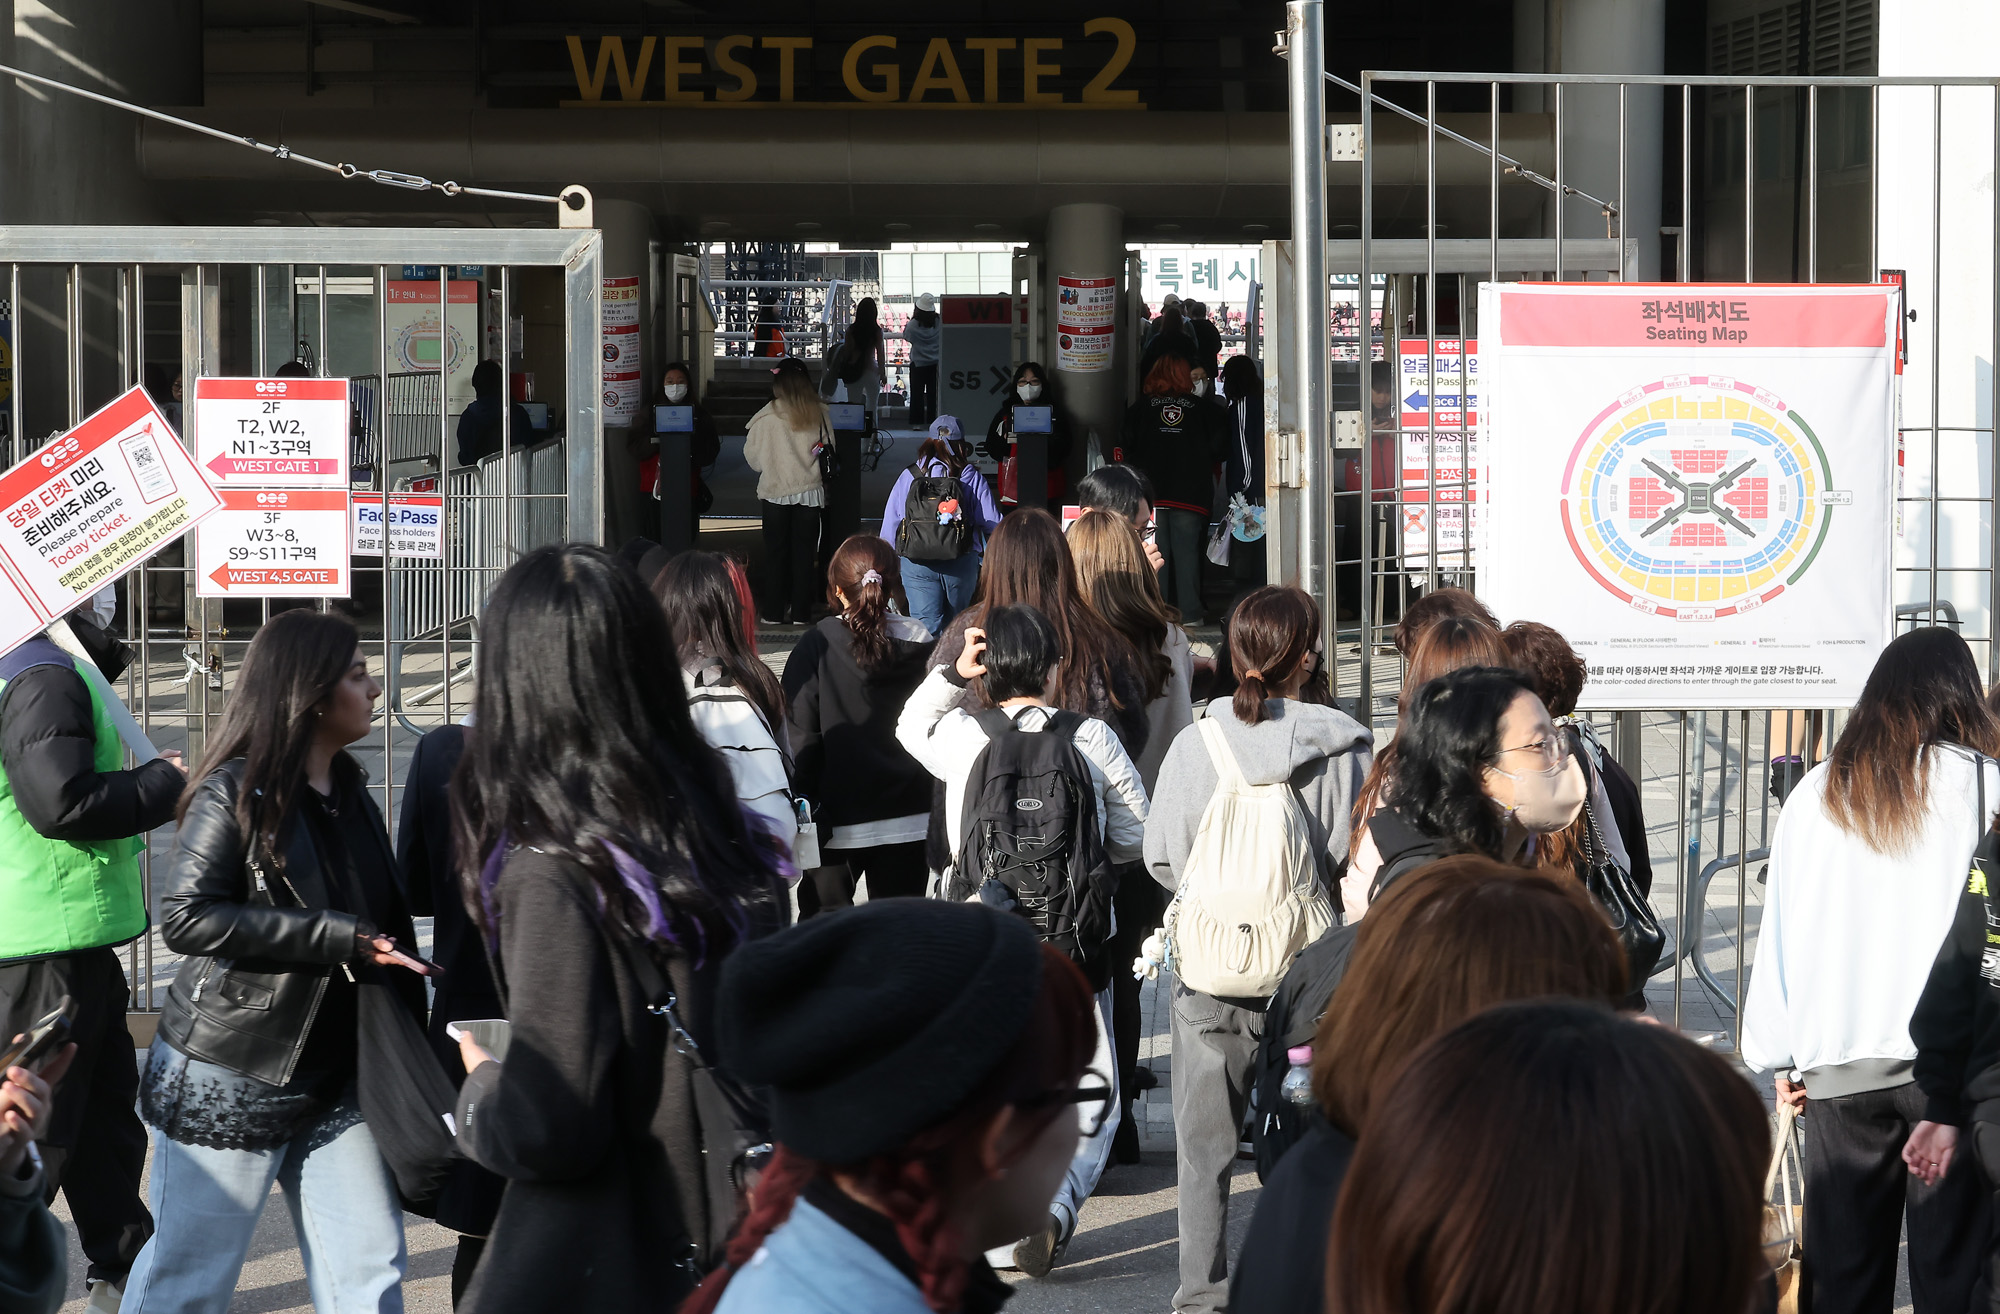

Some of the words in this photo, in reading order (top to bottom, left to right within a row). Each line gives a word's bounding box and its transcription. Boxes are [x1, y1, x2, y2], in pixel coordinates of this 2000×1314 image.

[565, 35, 813, 102] WEST
[842, 35, 1063, 103] GATE
[1082, 17, 1139, 103] 2
[390, 288, 399, 298] 1F
[402, 290, 416, 299] 안내
[622, 289, 637, 300] 불가
[968, 301, 1005, 320] W1
[1642, 300, 1750, 324] 좌석배치도
[1646, 326, 1707, 343] Seating
[1712, 326, 1748, 343] Map
[1403, 358, 1428, 373] 얼굴
[1436, 358, 1461, 373] 패스
[950, 371, 981, 390] S5
[1410, 377, 1429, 386] Fac
[1437, 377, 1460, 386] Pass
[1623, 395, 1638, 405] WEST
[1756, 393, 1770, 404] WEST
[262, 402, 281, 414] 2F
[238, 420, 264, 436] T2,
[269, 420, 305, 436] W2,
[233, 440, 311, 455] N1~3구역
[1114, 447, 1123, 461] 6
[233, 461, 272, 472] WEST
[274, 461, 310, 472] GATE
[314, 461, 319, 472] 1
[1424, 469, 1471, 480] I-PAS
[6, 499, 42, 528] 당일
[38, 478, 73, 507] 티켓
[70, 457, 104, 487] 미리
[22, 480, 116, 546] 준비해주세요.
[264, 512, 281, 524] 3F
[359, 508, 397, 522] Face
[401, 510, 437, 524] Pass
[38, 527, 78, 557] Please
[78, 497, 124, 533] prepare
[359, 526, 380, 535] Face
[403, 528, 435, 537] holders
[48, 538, 90, 569] Today
[89, 512, 131, 544] ticket.
[58, 568, 85, 587] 티켓이
[84, 554, 103, 571] 없을
[102, 543, 120, 560] 경우
[119, 527, 144, 548] 입장이
[143, 499, 188, 530] 불가합니다.
[246, 529, 299, 544] W3~8,
[358, 539, 375, 550] 얼굴
[398, 541, 415, 551] 등록
[418, 542, 436, 552] 관객
[72, 580, 88, 594] No
[88, 563, 114, 586] entry
[114, 539, 151, 569] without
[160, 514, 189, 536] ticket.
[229, 547, 316, 560] S9~S11구역
[228, 571, 268, 582] WEST
[270, 571, 291, 584] 4,5
[293, 571, 329, 582] GATE
[1634, 602, 1647, 611] EAST
[1740, 603, 1754, 611] EAST
[1586, 666, 1604, 675] 내를
[1607, 666, 1623, 675] 따라
[1626, 666, 1668, 675] 이동하시면
[1670, 666, 1695, 675] 좌석과
[1698, 666, 1722, 675] 가까운
[1724, 666, 1758, 675] 게이트로
[1760, 666, 1777, 675] 입장
[1779, 665, 1824, 675] 가능합니다.
